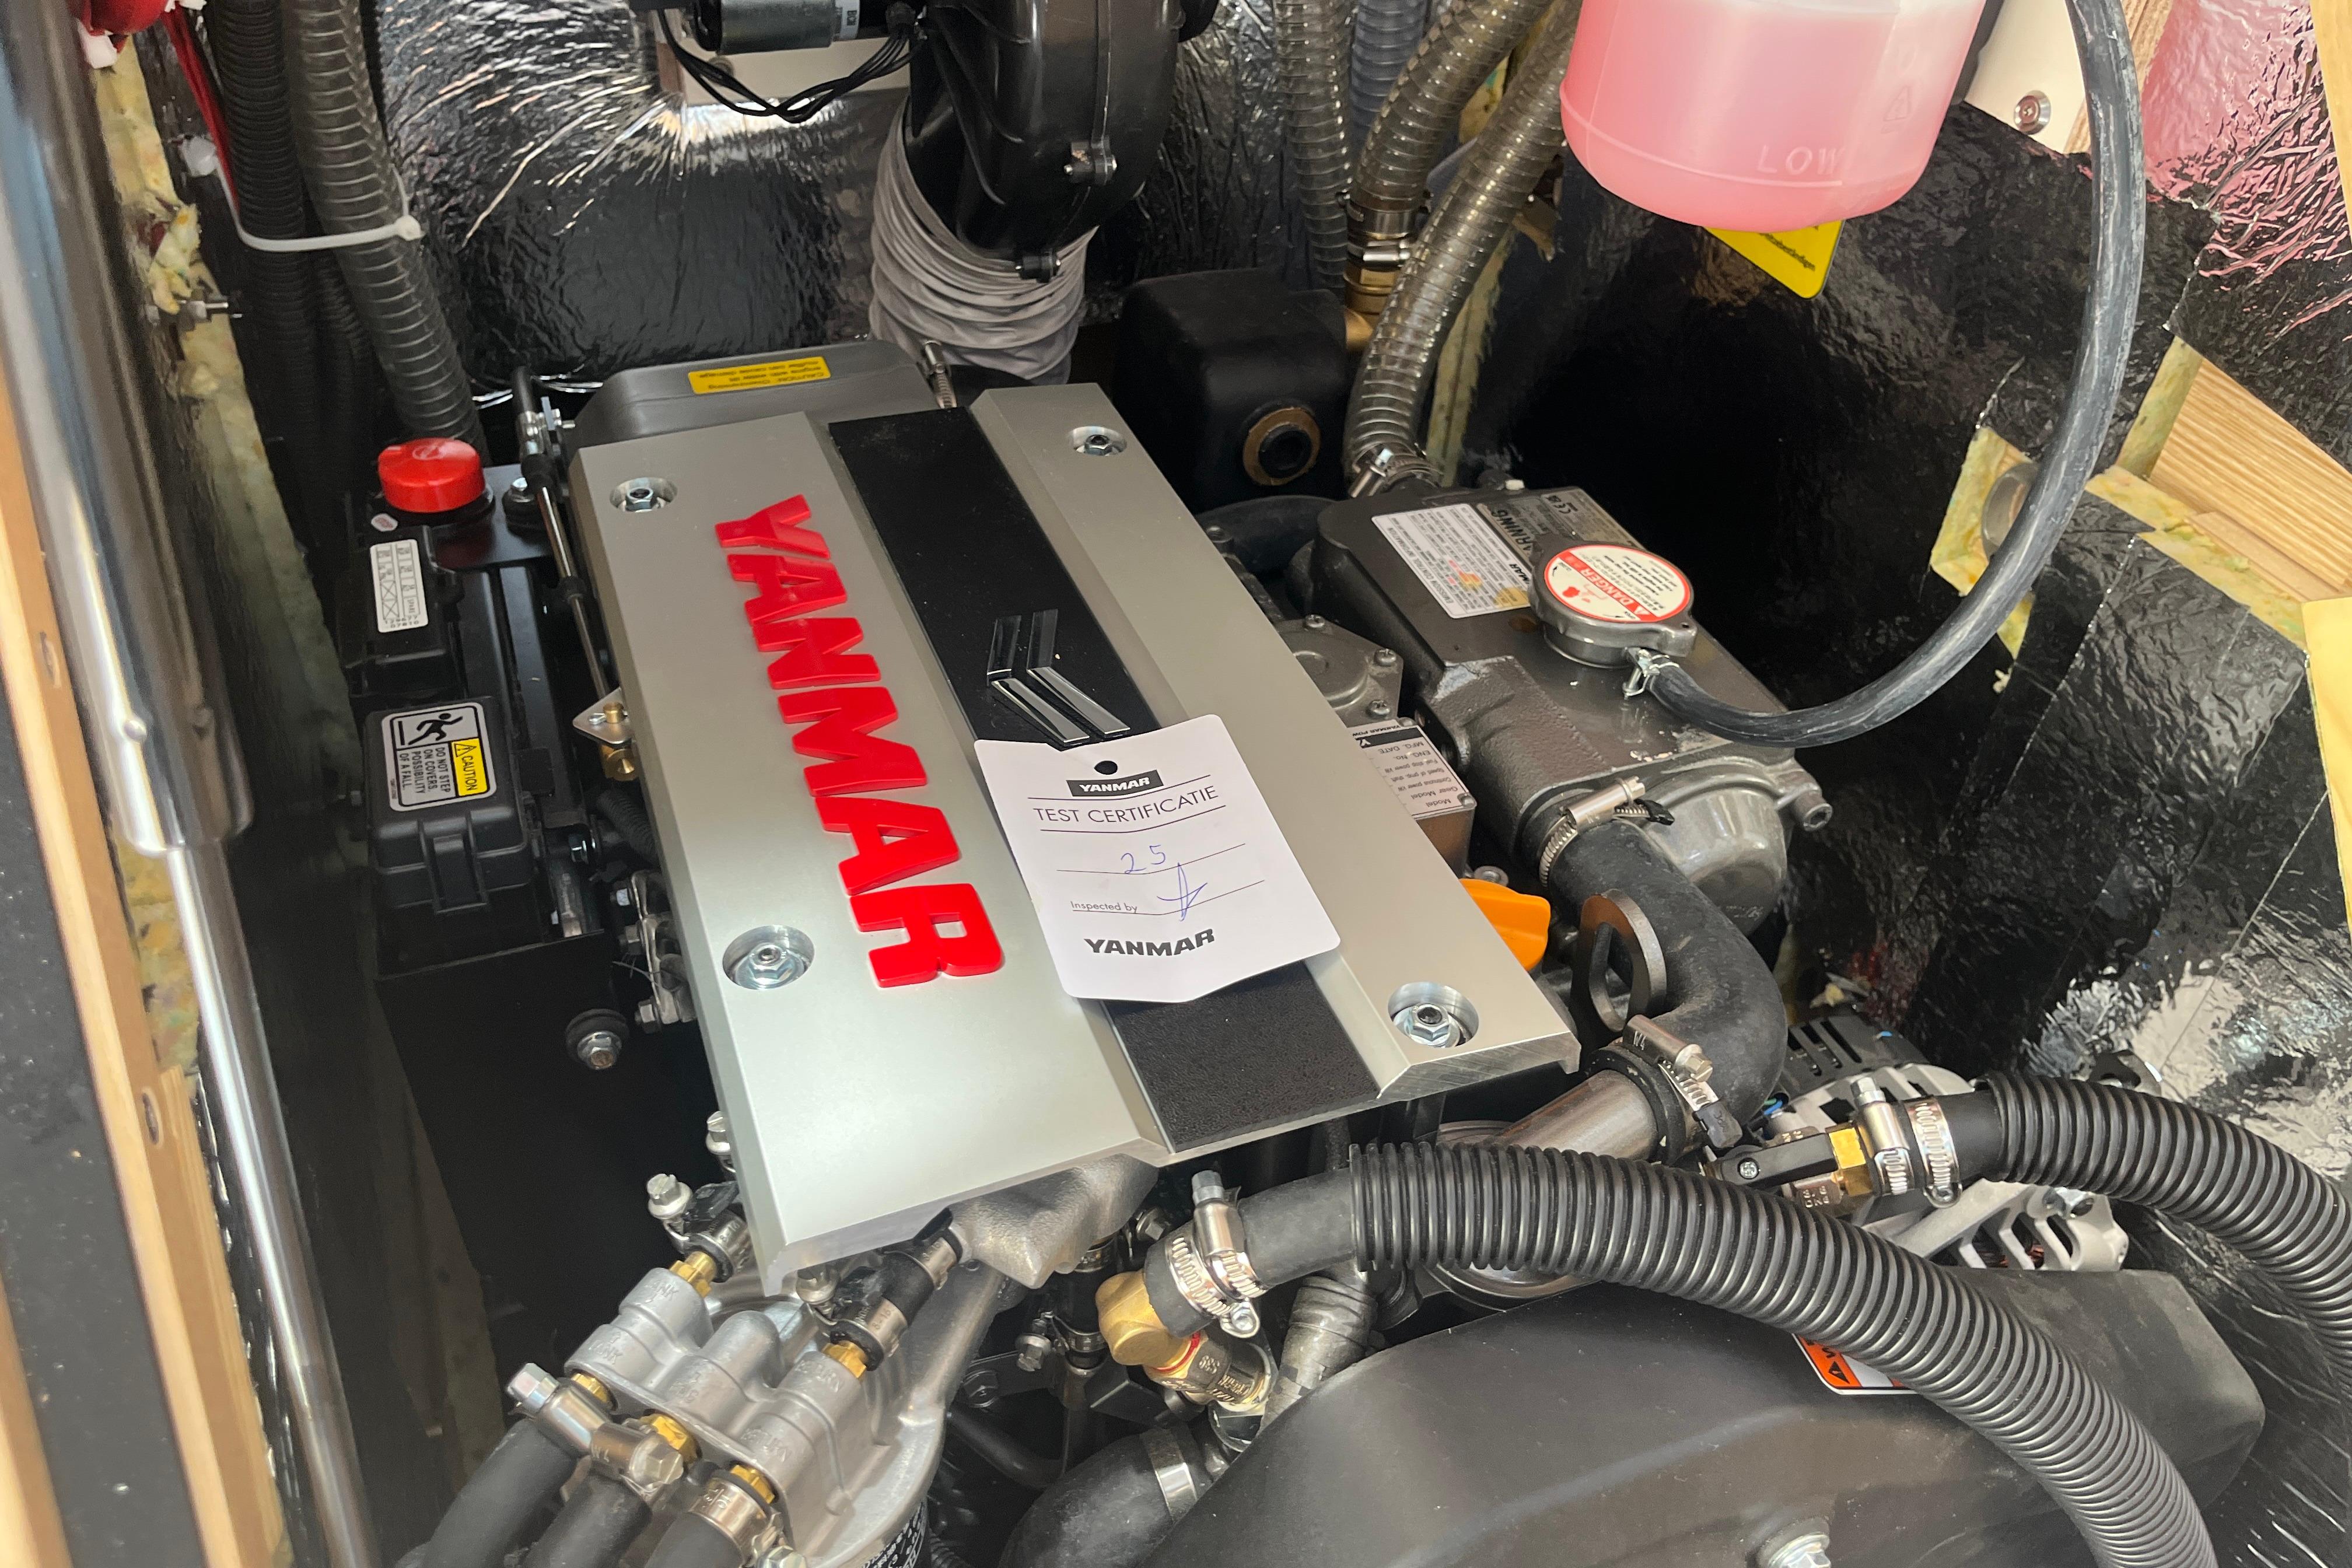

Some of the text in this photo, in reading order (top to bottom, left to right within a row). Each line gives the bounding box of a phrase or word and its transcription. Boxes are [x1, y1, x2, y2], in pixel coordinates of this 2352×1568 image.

[1756, 144, 1847, 174] LOW
[1580, 567, 1634, 606] DANGER
[423, 749, 433, 760] ON
[715, 494, 1004, 988] YANMAR
[1377, 745, 1401, 754] DATE
[399, 753, 410, 762] OF
[411, 750, 426, 794] POSSIBILITY
[435, 747, 452, 793] DO NOT STEP
[461, 755, 478, 792] CAUTION
[1079, 776, 1150, 794] YANMAR
[1032, 785, 1219, 823] TEST CERTIFICATIE
[1411, 790, 1436, 800] Model
[1426, 798, 1451, 807] Model
[1070, 900, 1138, 914] Inspected by
[1083, 928, 1216, 957] YANMAR
